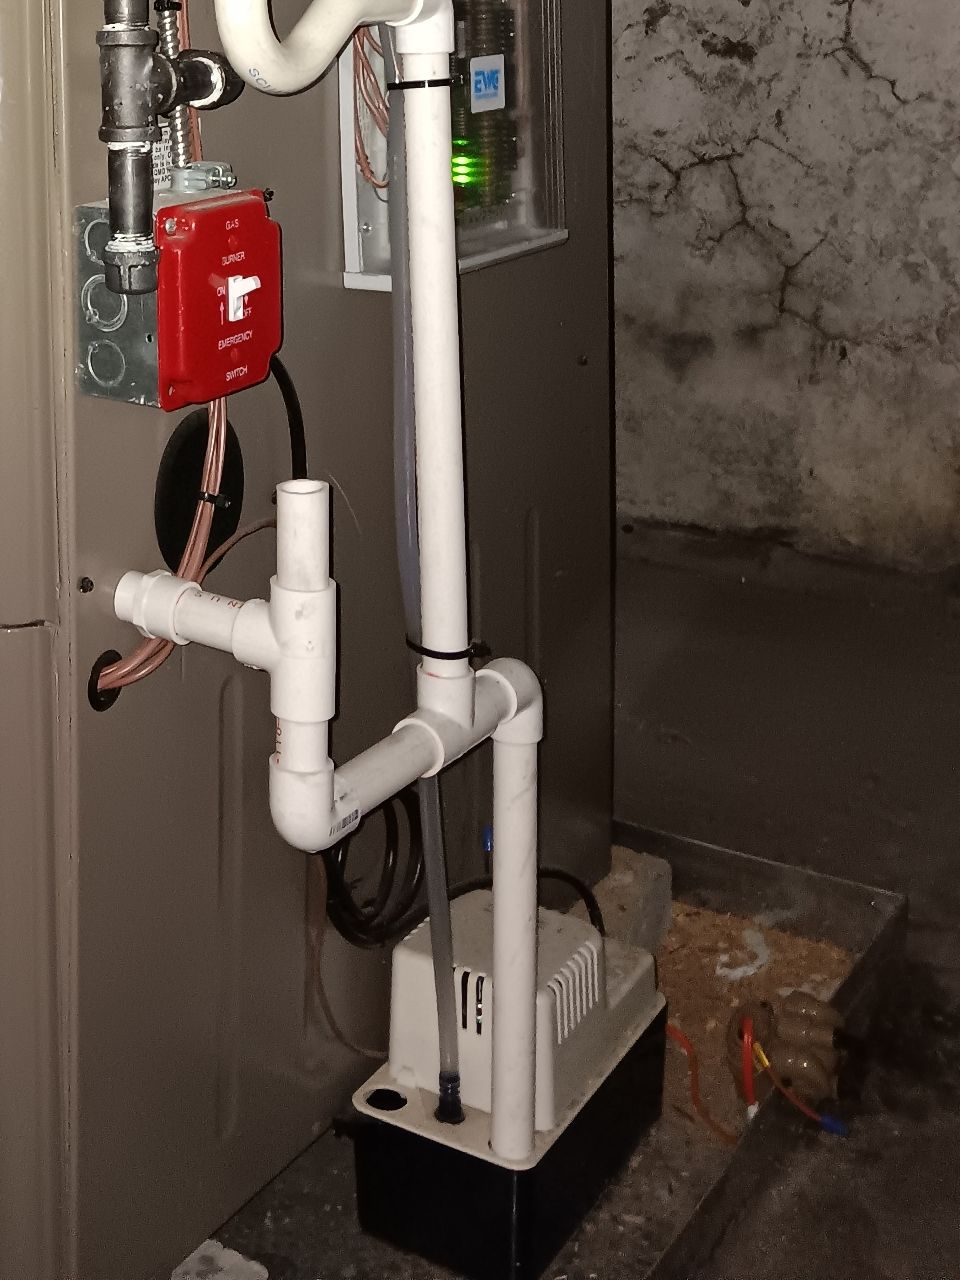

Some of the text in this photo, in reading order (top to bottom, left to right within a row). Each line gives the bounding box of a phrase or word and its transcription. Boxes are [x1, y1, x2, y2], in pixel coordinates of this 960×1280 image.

[225, 218, 240, 231] GAS
[221, 251, 246, 267] BURNER
[216, 285, 226, 297] ON
[218, 329, 253, 351] EMERGENCY
[225, 365, 249, 382] SWITCH
